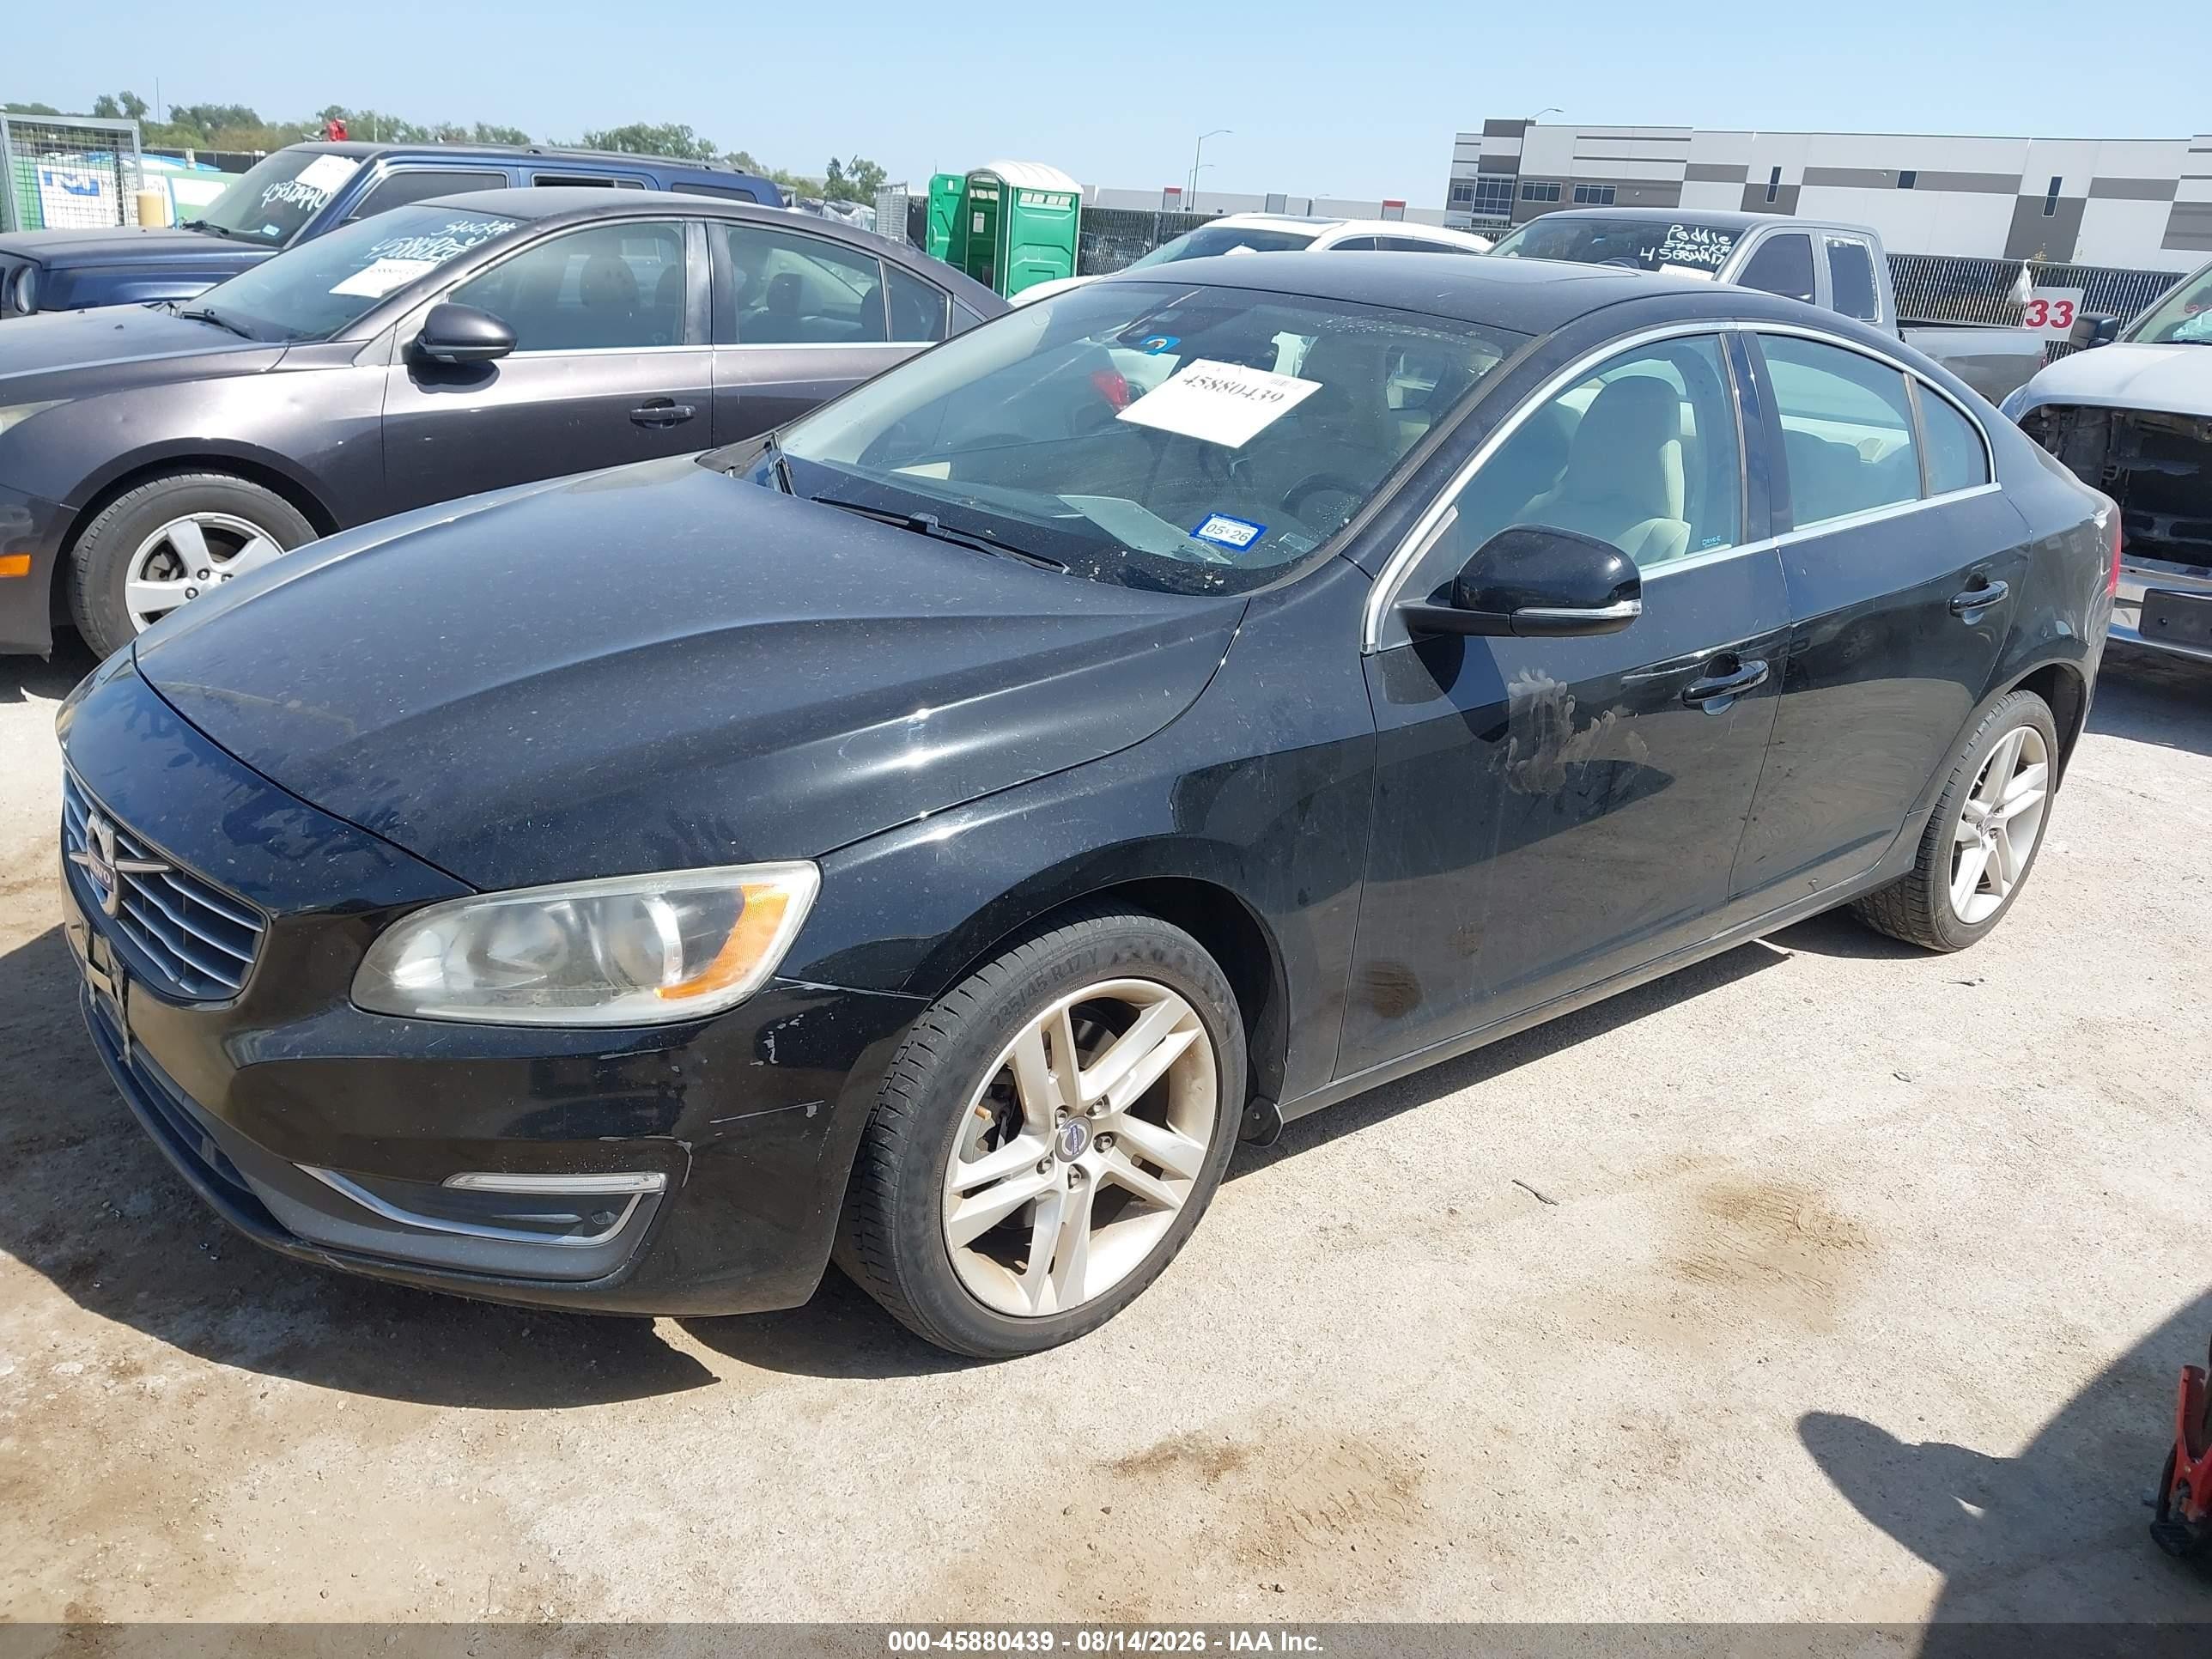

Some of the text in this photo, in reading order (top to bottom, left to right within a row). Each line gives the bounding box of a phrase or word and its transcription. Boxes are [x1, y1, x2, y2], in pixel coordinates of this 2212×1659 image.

[1663, 240, 1733, 255] Stock#
[2025, 299, 2075, 329] 33
[1182, 374, 1285, 404] 45880439
[1206, 523, 1226, 535] 05
[1229, 530, 1251, 542] 26
